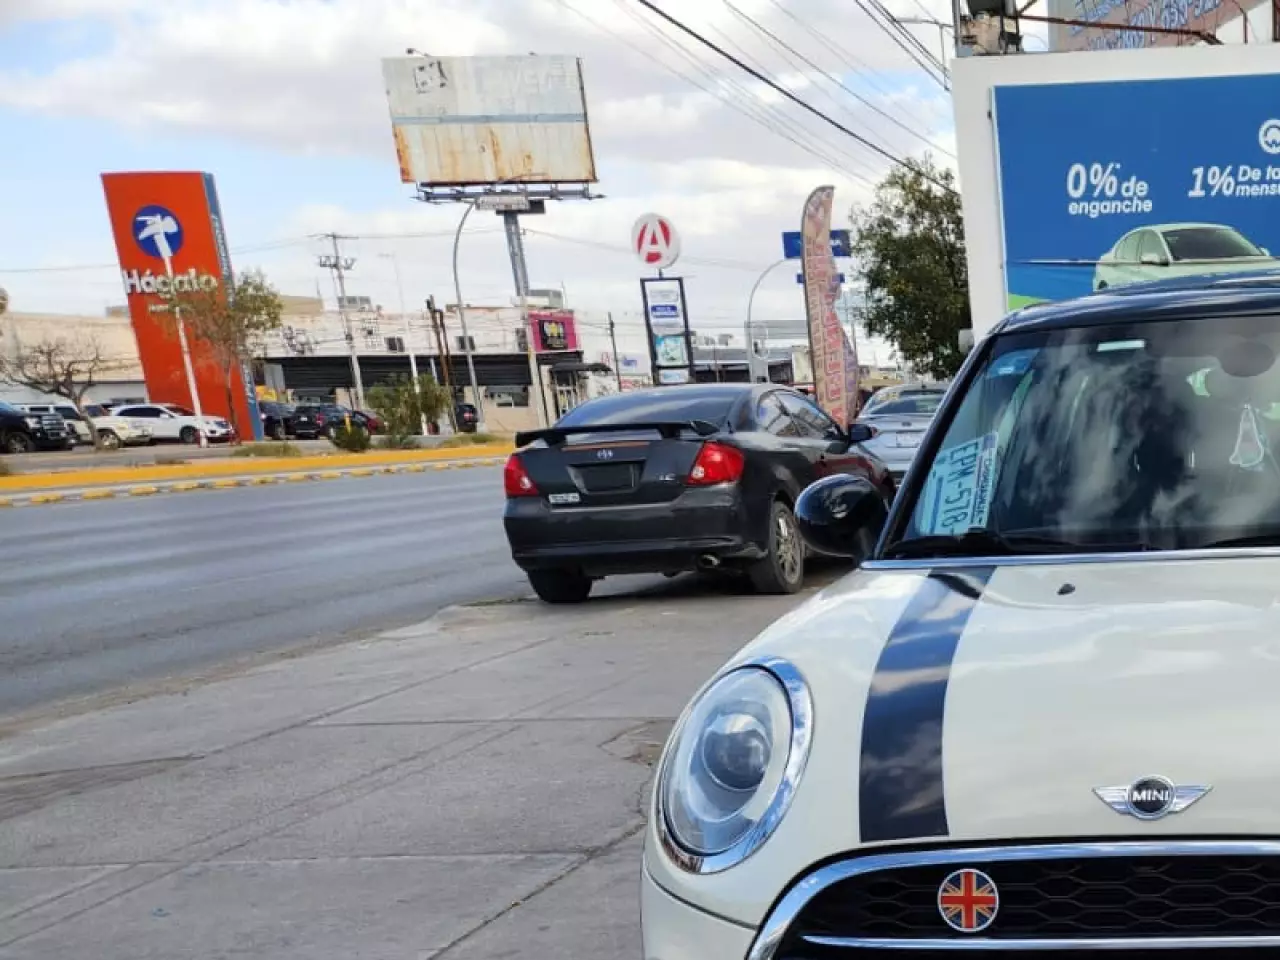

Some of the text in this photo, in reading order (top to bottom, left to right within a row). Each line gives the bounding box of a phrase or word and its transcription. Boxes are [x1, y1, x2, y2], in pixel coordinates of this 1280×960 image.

[1187, 165, 1236, 198] 1%
[1237, 165, 1262, 182] De
[1121, 175, 1149, 197] de
[1068, 197, 1152, 218] enganche
[1132, 789, 1169, 803] MINI
